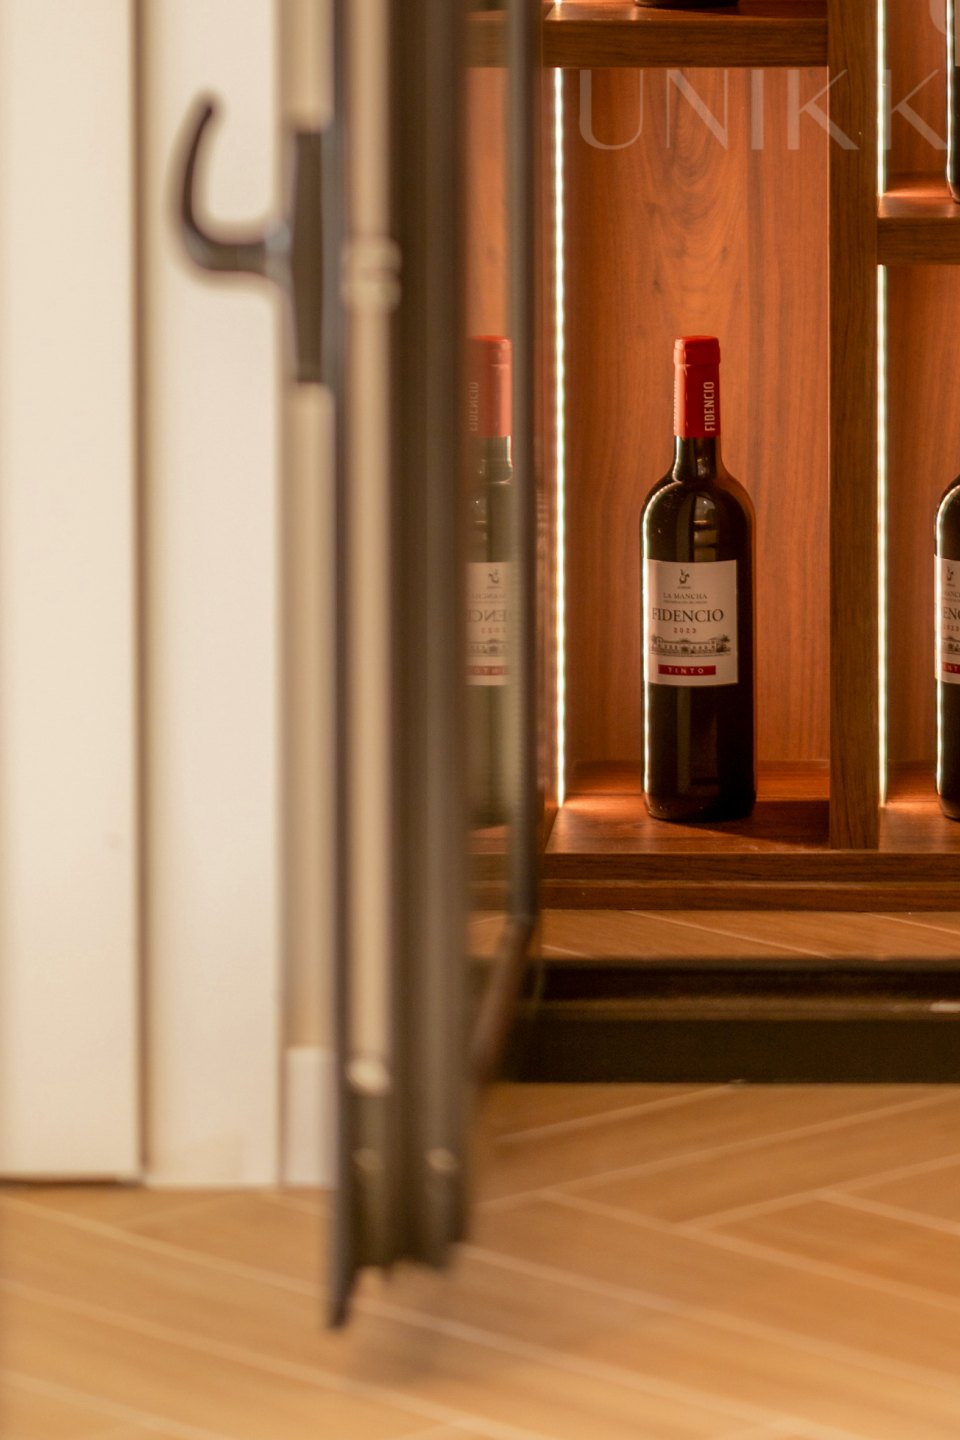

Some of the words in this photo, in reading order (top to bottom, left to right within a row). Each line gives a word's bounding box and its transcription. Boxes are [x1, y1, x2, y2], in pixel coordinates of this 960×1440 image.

[703, 381, 716, 432] FIDENCIO
[652, 607, 725, 622] FIDENCIO
[667, 666, 704, 674] TINTO
